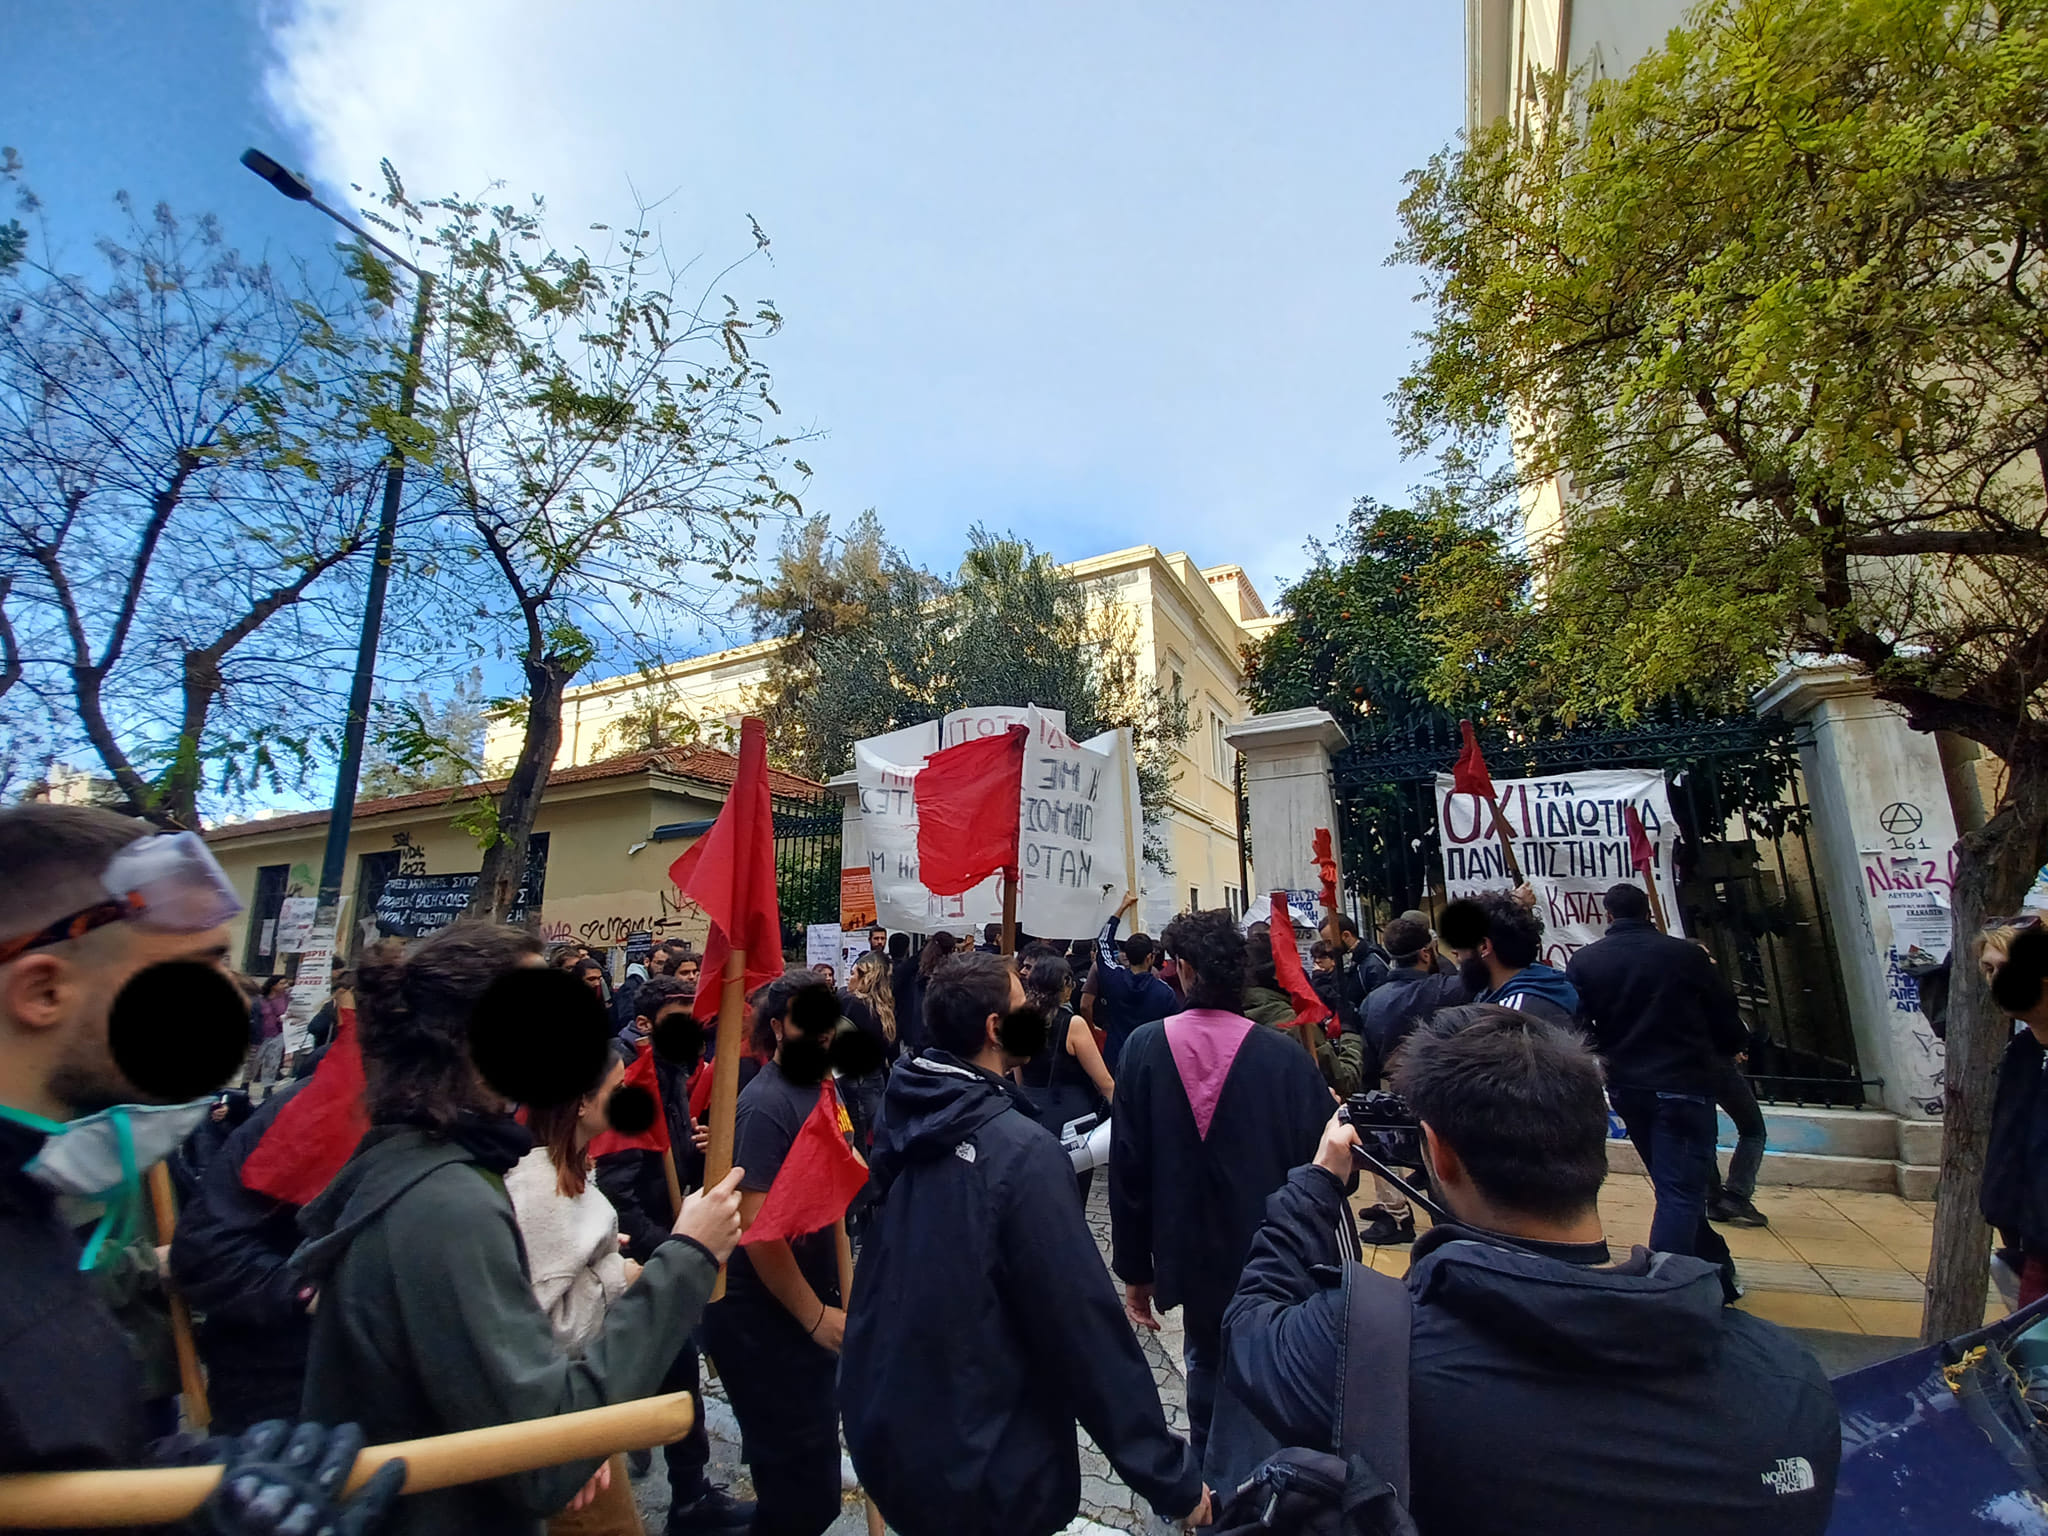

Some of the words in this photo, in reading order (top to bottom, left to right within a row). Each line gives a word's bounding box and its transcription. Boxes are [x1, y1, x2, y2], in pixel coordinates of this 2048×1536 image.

[1533, 780, 1575, 799] ΣΤΑ
[1443, 784, 1532, 844] ΟΧΙ
[1886, 837, 1932, 850] 161
[1447, 840, 1661, 881] ΠΑΝΕΠΙΣΤΗΜΙ!
[1776, 1457, 1797, 1472] THE
[1760, 1468, 1799, 1485] NORTH
[1775, 1481, 1801, 1495] FACE
